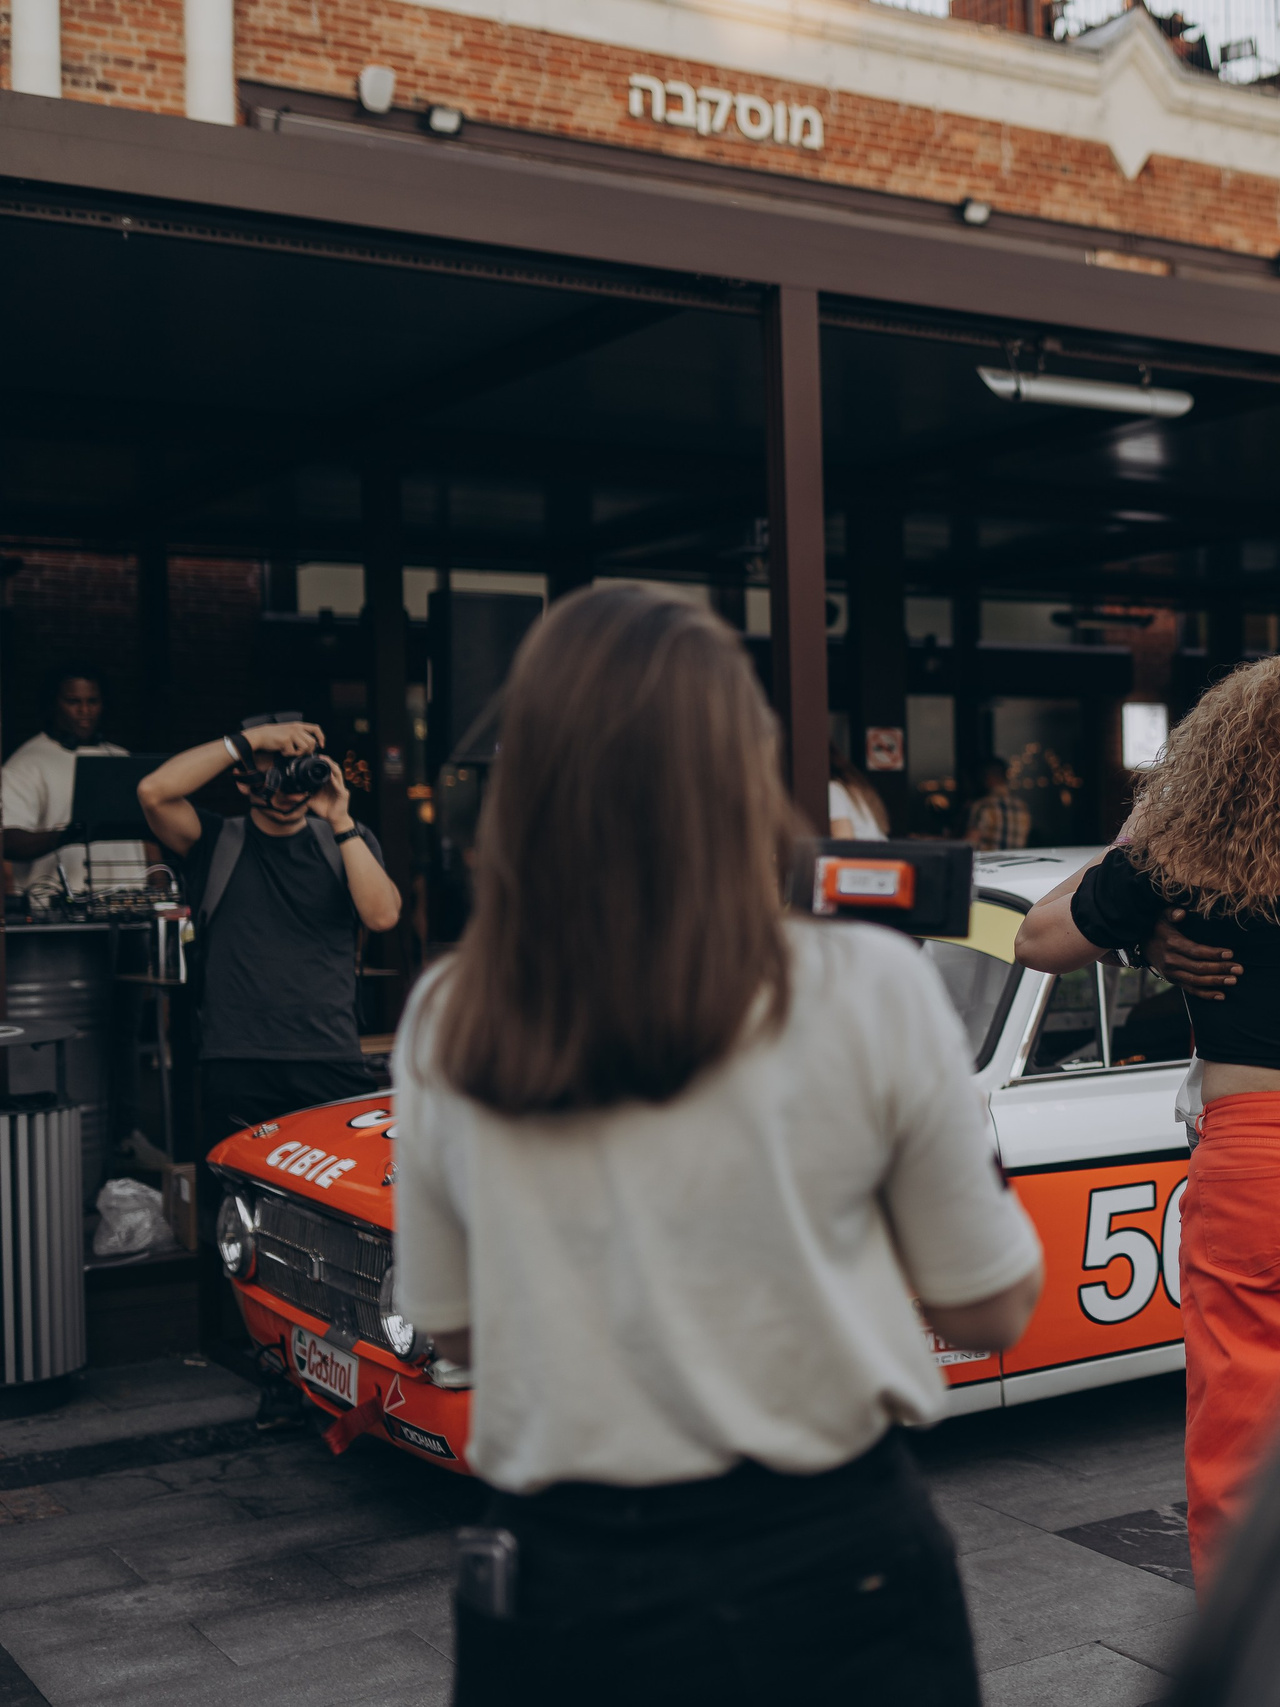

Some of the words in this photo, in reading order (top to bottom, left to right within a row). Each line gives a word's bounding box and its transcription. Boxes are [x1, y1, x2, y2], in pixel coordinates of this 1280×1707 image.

[628, 72, 825, 150] מוסקבה
[1077, 1174, 1189, 1326] 5
[306, 1338, 353, 1400] Castrol
